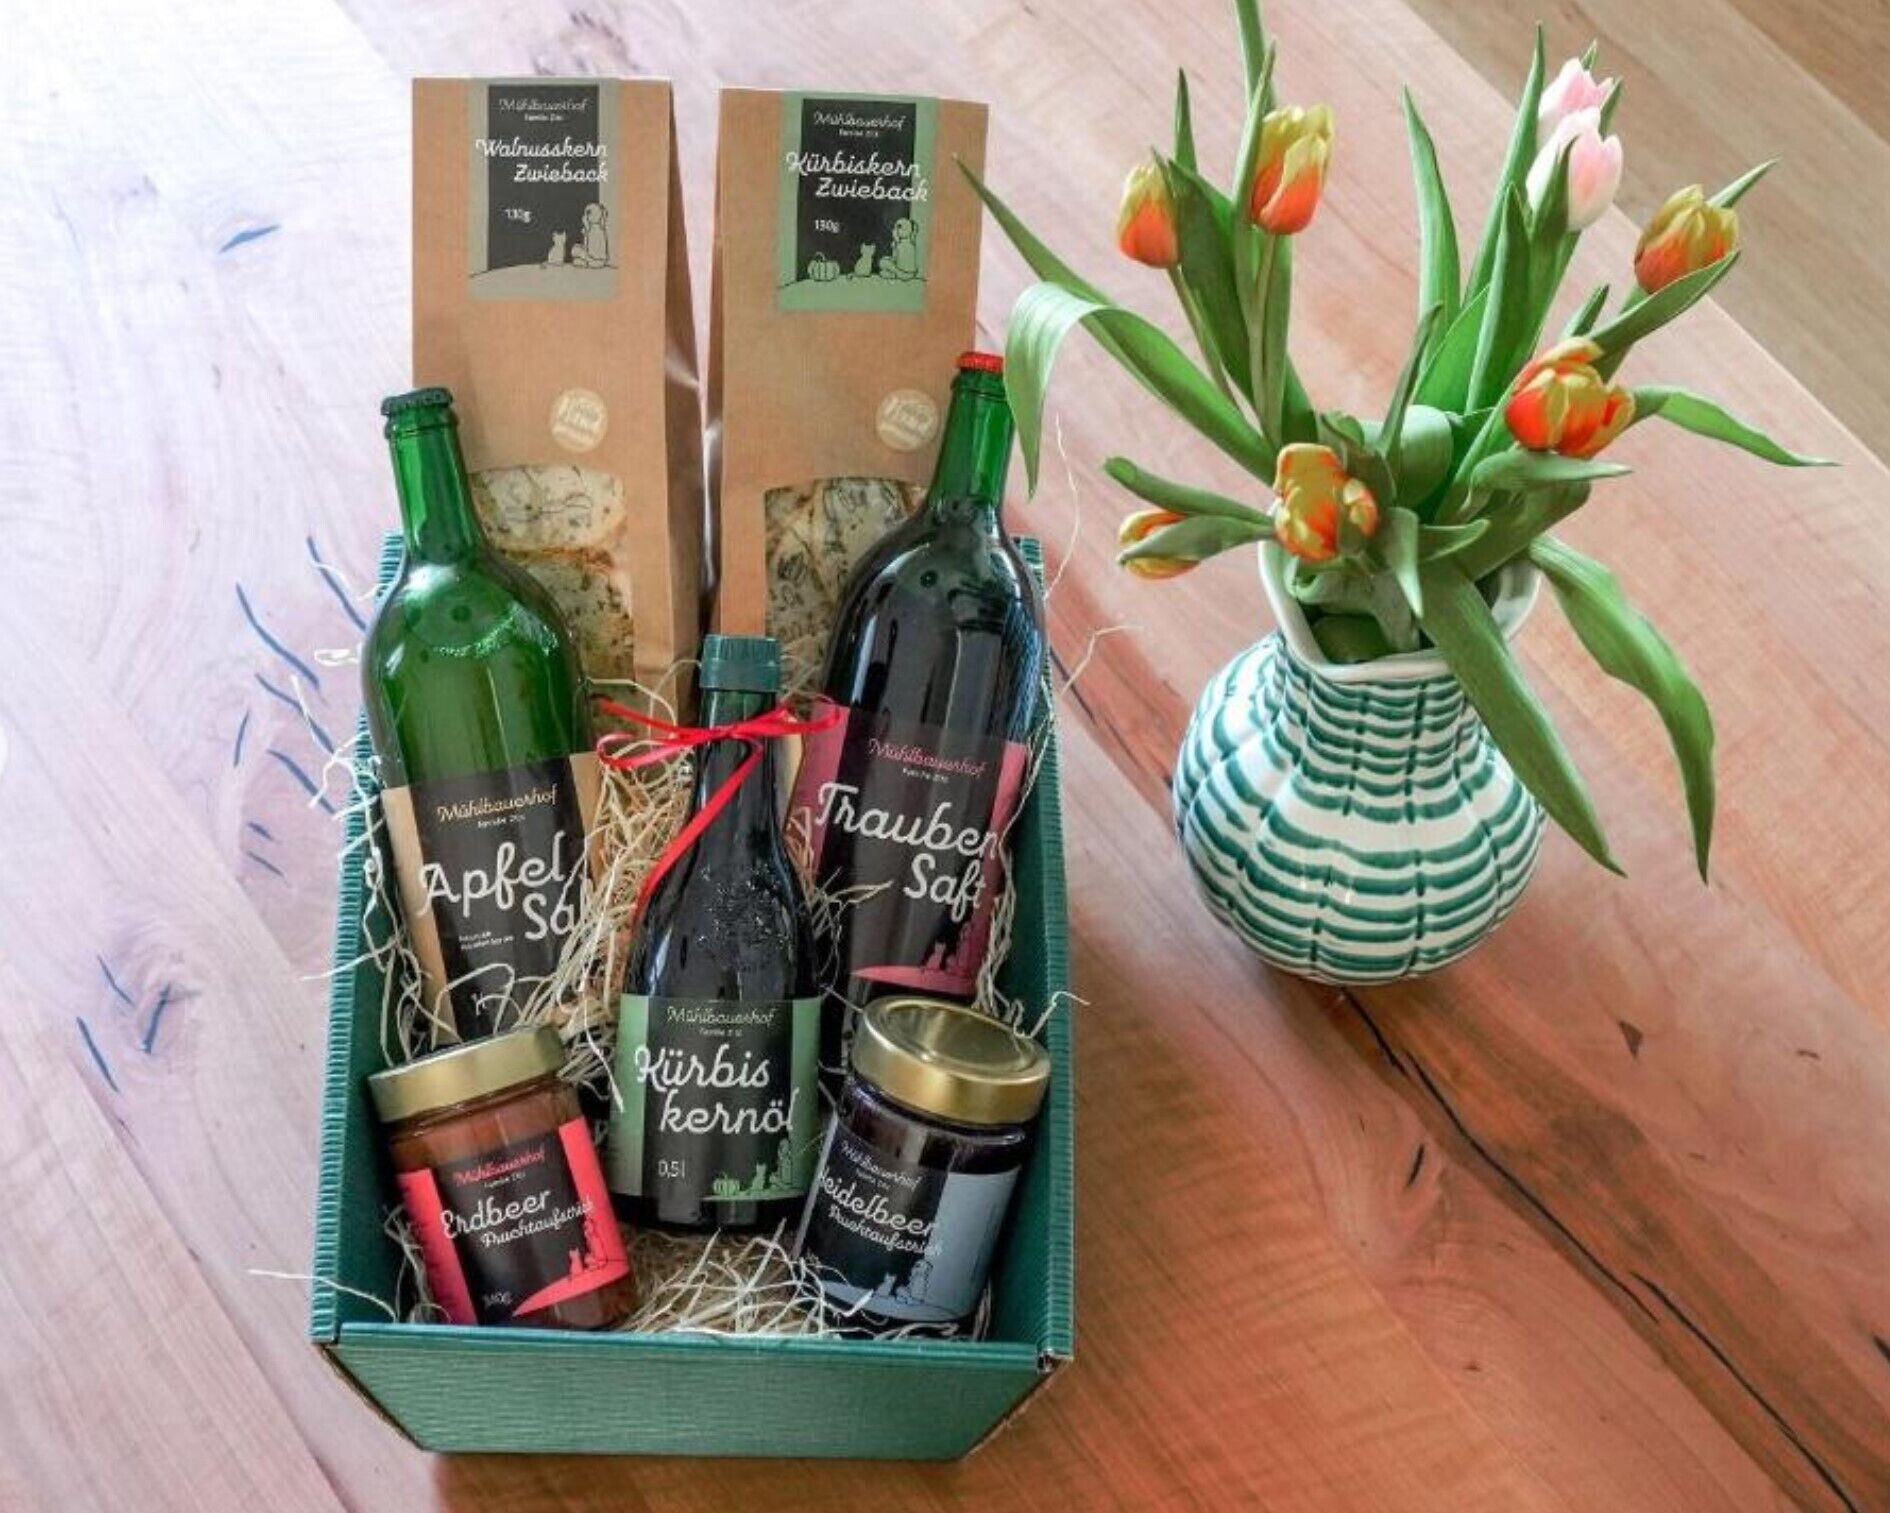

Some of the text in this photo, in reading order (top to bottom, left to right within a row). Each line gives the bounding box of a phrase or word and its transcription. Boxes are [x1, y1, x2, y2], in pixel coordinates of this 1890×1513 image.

[476, 136, 607, 157] Walnusskern
[786, 151, 921, 178] Kürbiskern
[513, 161, 609, 182] Zwieback
[815, 176, 928, 201] Zwieback
[815, 782, 998, 859] Trauben
[418, 830, 566, 918] Apfel
[903, 853, 987, 923] Saft
[635, 1043, 770, 1092] Kürbis
[659, 1086, 800, 1134] kernöl
[440, 1190, 550, 1239] Erdbeer
